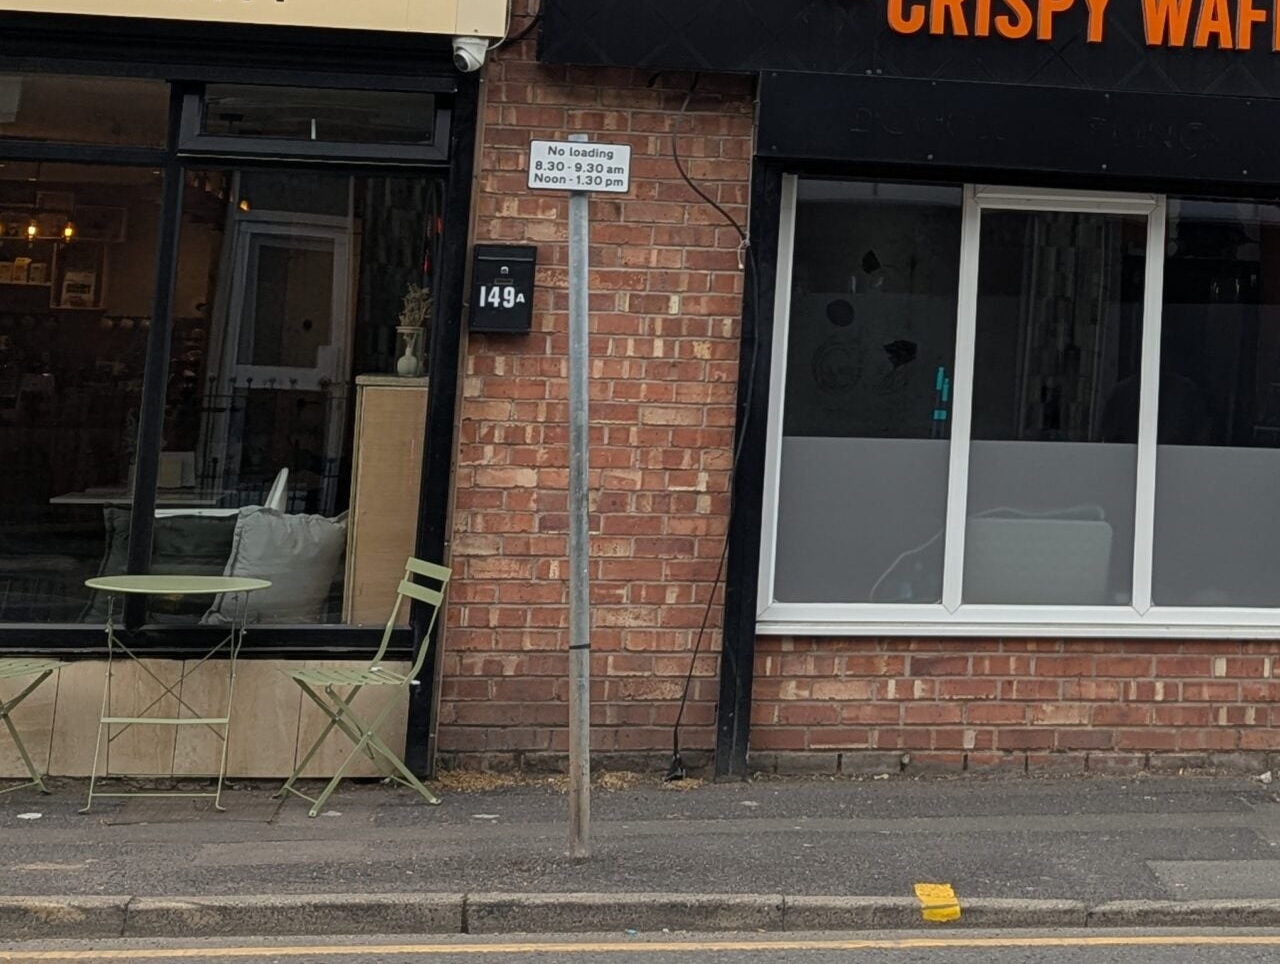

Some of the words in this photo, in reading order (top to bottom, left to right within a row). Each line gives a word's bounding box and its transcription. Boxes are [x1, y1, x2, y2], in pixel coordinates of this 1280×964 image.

[547, 145, 565, 156] No
[569, 146, 614, 161] loading
[534, 160, 565, 172] 8.30
[574, 162, 604, 173] 9.30
[606, 166, 625, 175] am
[533, 172, 567, 184] Noon
[576, 175, 603, 186] 1.30
[605, 179, 624, 188] pm
